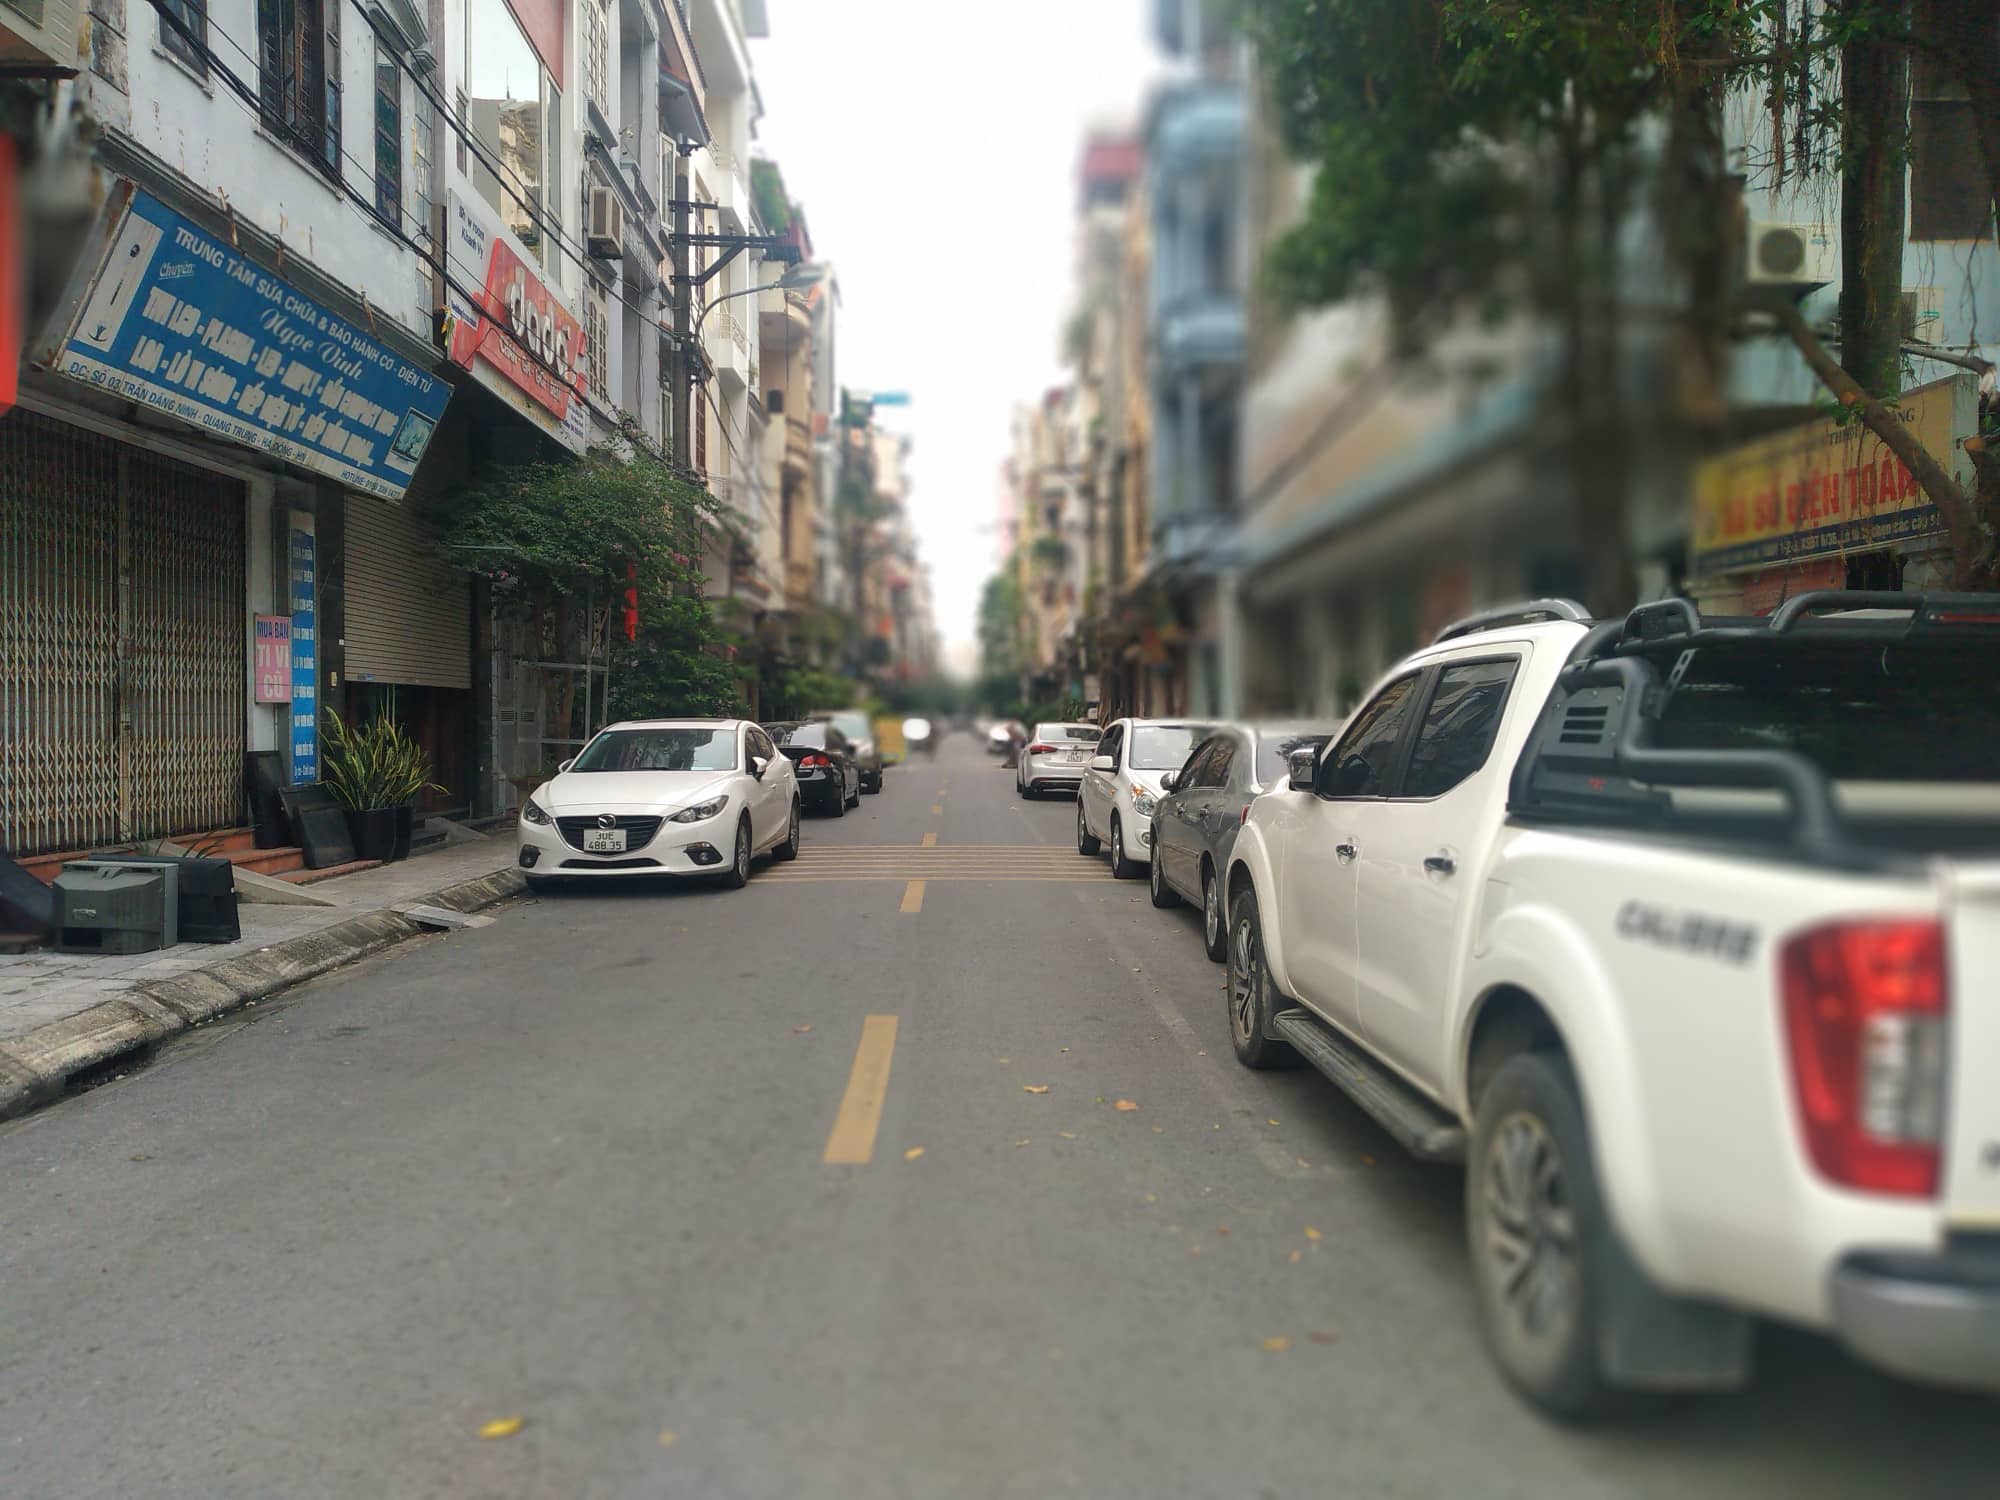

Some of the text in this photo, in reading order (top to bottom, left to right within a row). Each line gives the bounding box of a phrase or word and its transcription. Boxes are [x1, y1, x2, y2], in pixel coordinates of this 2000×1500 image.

[175, 227, 225, 268] TRUNG
[225, 258, 257, 288] TÂM
[318, 316, 328, 331] &
[260, 308, 363, 381] Ngọc Vinh
[108, 376, 121, 393] 03
[122, 380, 150, 402] TRẦN
[175, 403, 199, 419] NINH
[203, 414, 232, 433] QUANG
[232, 425, 258, 444] TRUNG
[256, 621, 273, 638] MUA
[256, 644, 271, 668] TI
[275, 644, 289, 668] VI
[263, 670, 284, 698] CŨ
